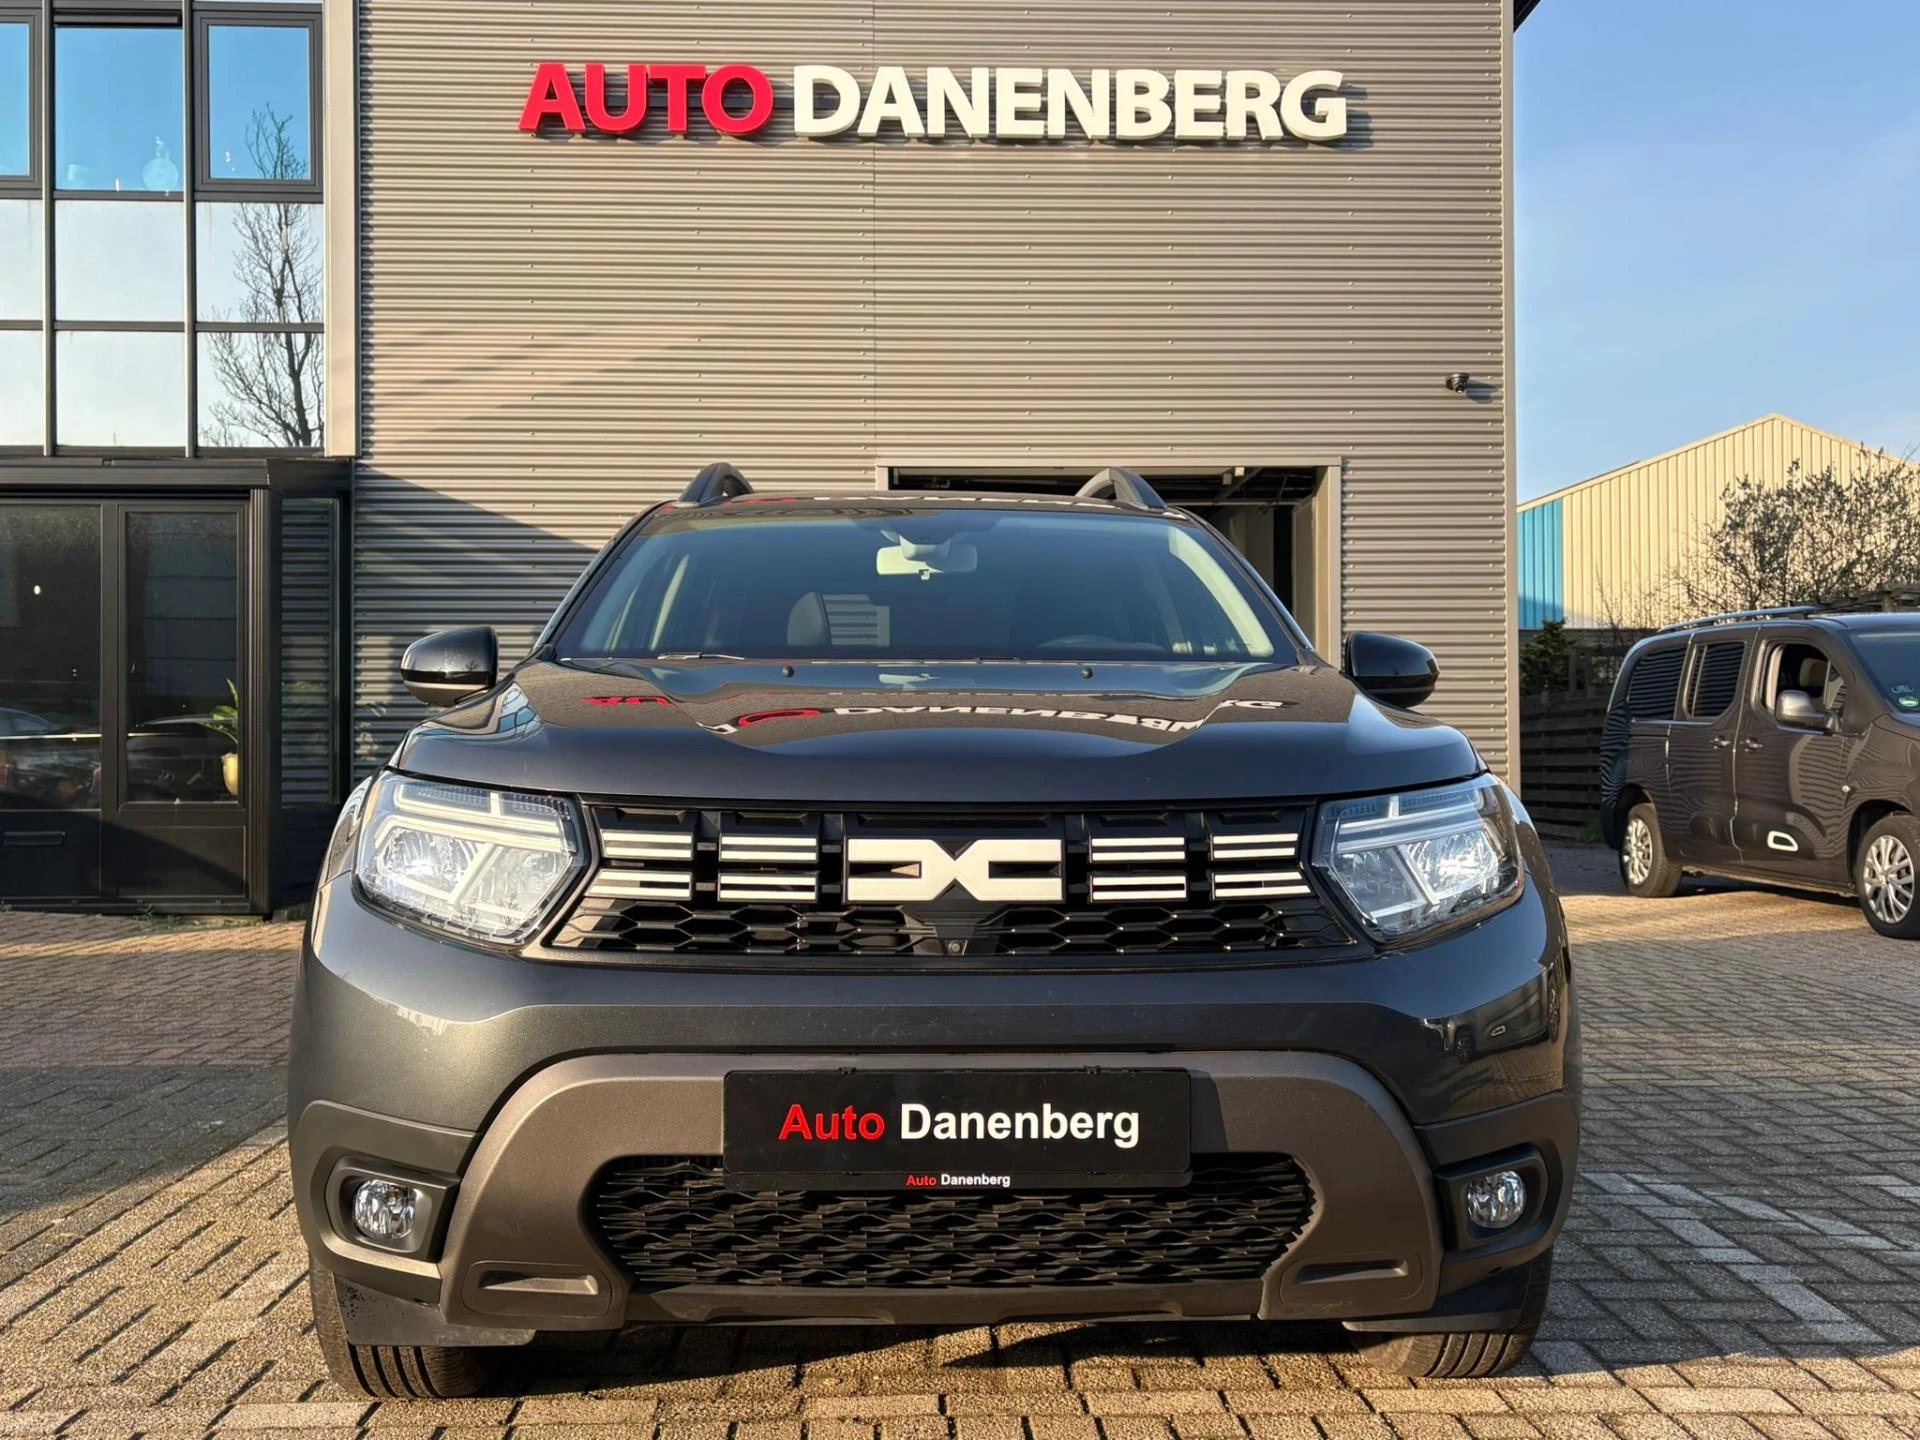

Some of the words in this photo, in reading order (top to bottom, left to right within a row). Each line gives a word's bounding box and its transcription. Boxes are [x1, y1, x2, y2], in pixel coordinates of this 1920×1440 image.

[518, 63, 774, 134] AUTO
[793, 66, 1348, 141] DANENBERG
[778, 1103, 885, 1141] Auto
[900, 1103, 1140, 1149] Danenberg
[906, 1174, 937, 1187] Auto
[941, 1174, 1011, 1188] Danenberg
